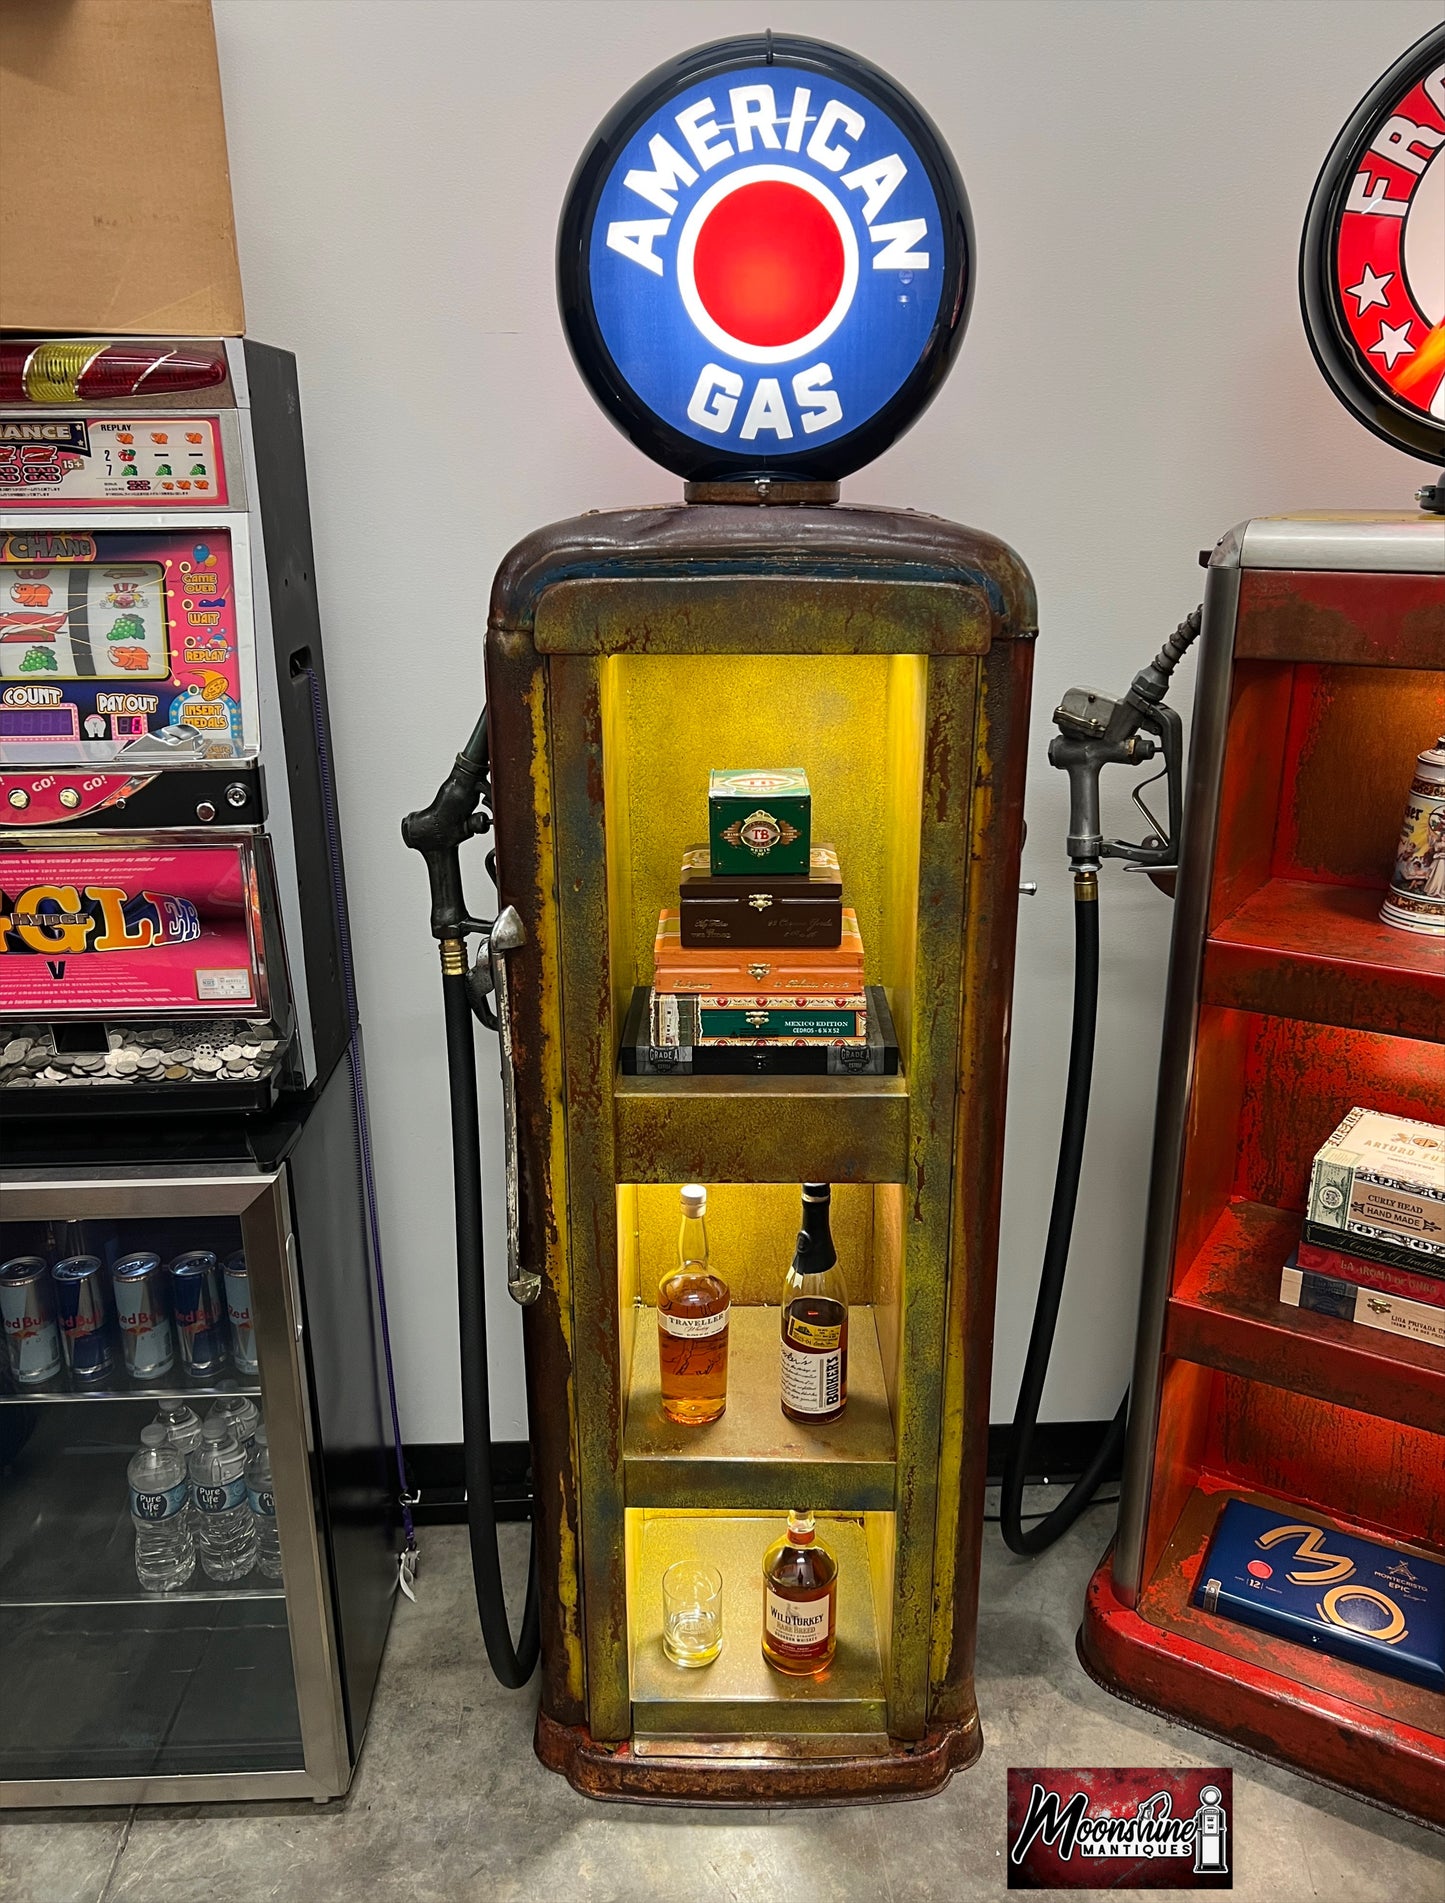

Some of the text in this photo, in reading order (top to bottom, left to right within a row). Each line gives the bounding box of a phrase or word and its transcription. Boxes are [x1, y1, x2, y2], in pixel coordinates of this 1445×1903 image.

[606, 84, 930, 277] AMERICAN
[687, 363, 843, 440] GAS
[0, 424, 71, 439] ANCE
[100, 424, 132, 432] REPLAY
[104, 449, 112, 462] 2
[63, 460, 82, 469] 15+
[105, 464, 113, 476] 7
[183, 573, 217, 584] GAME
[184, 583, 216, 593] OVER
[188, 611, 219, 625] WAIT
[185, 649, 226, 662] REPLAY
[5, 687, 61, 705] COUNT
[98, 695, 158, 713] PAY OUT
[185, 704, 222, 716] INSERT
[183, 716, 227, 729] MEDALS
[31, 775, 57, 792] GO!
[82, 774, 108, 791] GO!
[751, 829, 770, 840] TB
[10, 912, 90, 927] Hyper
[45, 960, 66, 980] V
[649, 1048, 680, 1061] GRADE A
[840, 1048, 865, 1060] GRADE
[1363, 1139, 1416, 1157] ARTURO
[1367, 1194, 1424, 1214] CURLY HEAD
[1366, 1206, 1421, 1227] HAND MADE
[228, 1303, 250, 1320] Red
[3, 1317, 20, 1329] ed
[668, 1313, 724, 1327] TRAVELLER
[1391, 1315, 1406, 1324] LIGA
[1407, 1320, 1436, 1333] PRIVADA
[826, 1355, 839, 1406] BOOKER'S
[200, 1487, 221, 1497] Pure
[139, 1494, 162, 1504] Pure
[202, 1494, 220, 1505] Life
[142, 1502, 160, 1513] Life
[1249, 1578, 1261, 1589] 12
[1374, 1571, 1428, 1592] MONTECRISTO
[1388, 1581, 1411, 1594] EPIC
[770, 1604, 824, 1627] WILD TURKEY
[793, 1626, 816, 1634] BREED
